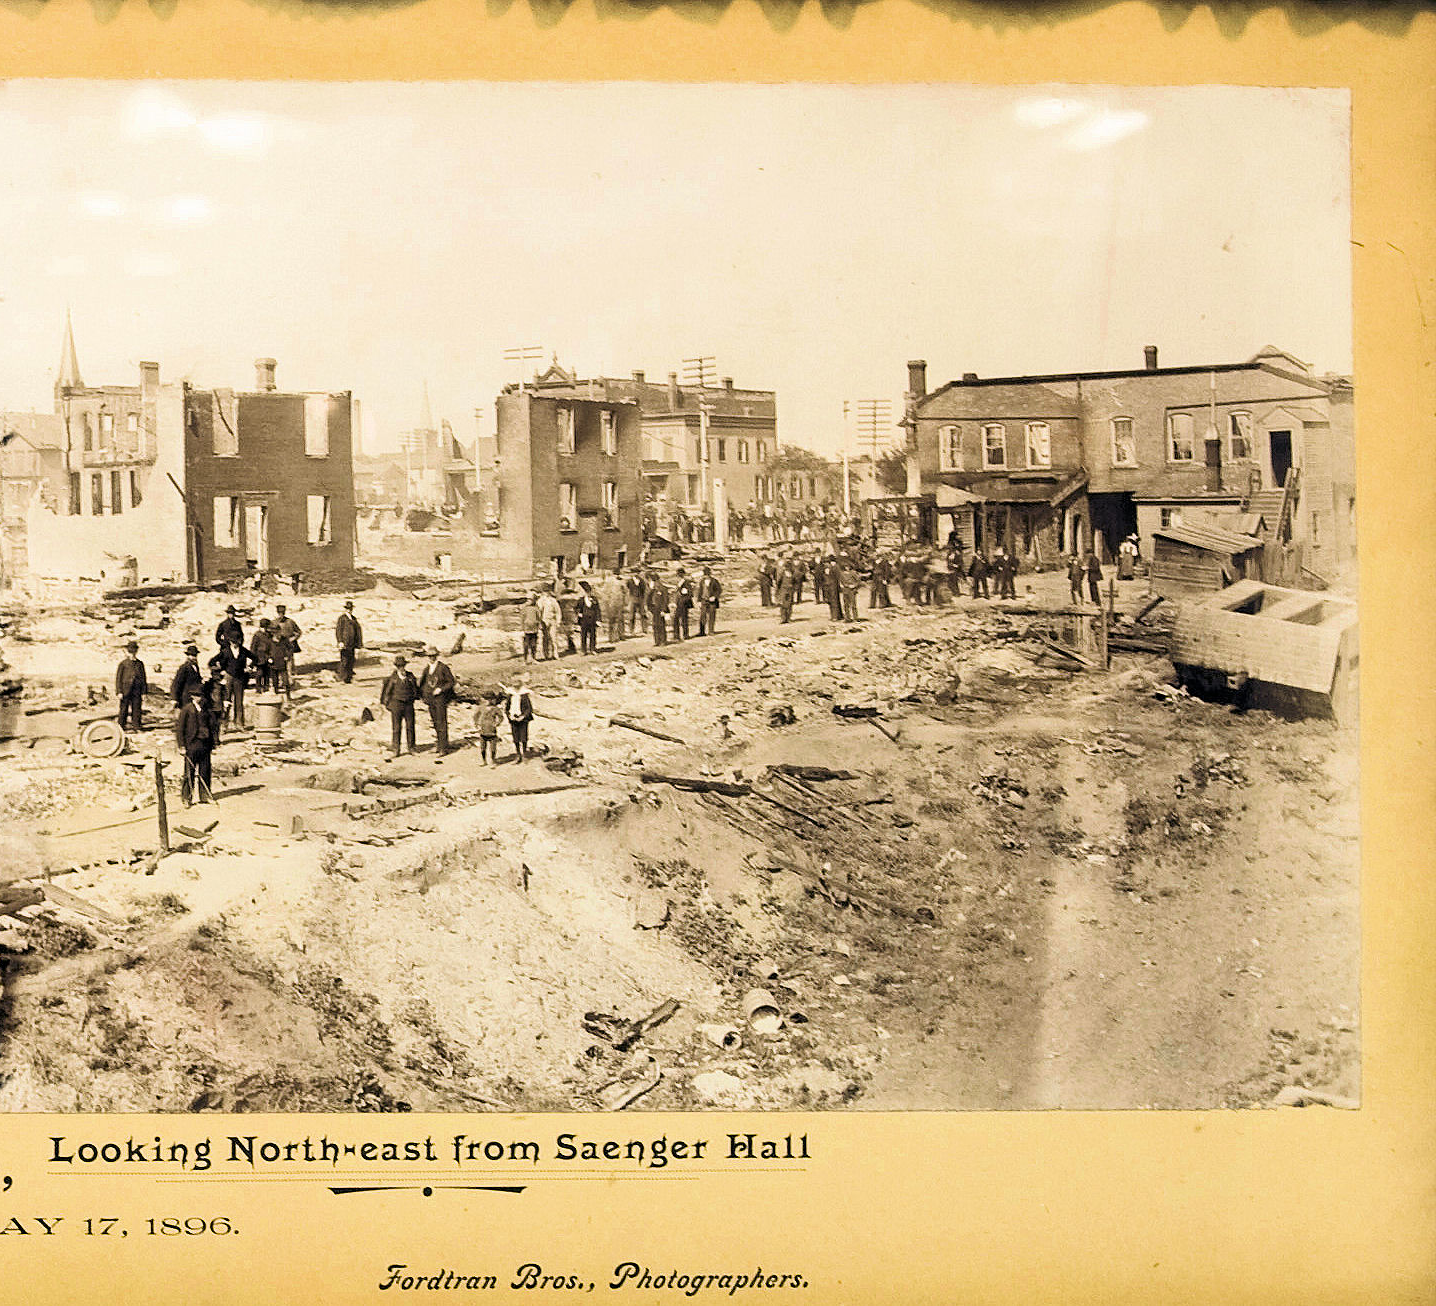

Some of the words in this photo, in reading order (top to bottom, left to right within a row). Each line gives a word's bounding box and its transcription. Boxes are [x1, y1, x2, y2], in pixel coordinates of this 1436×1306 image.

[48, 1136, 213, 1171] Looking
[450, 1134, 541, 1167] from
[554, 1133, 710, 1169] Saenger
[725, 1133, 812, 1161] Hall
[83, 1217, 129, 1239] 17,
[146, 1216, 241, 1237] 1896.
[377, 1263, 498, 1292] Fordtran
[509, 1262, 596, 1293] Bros.,
[608, 1261, 810, 1297] Photographers.
